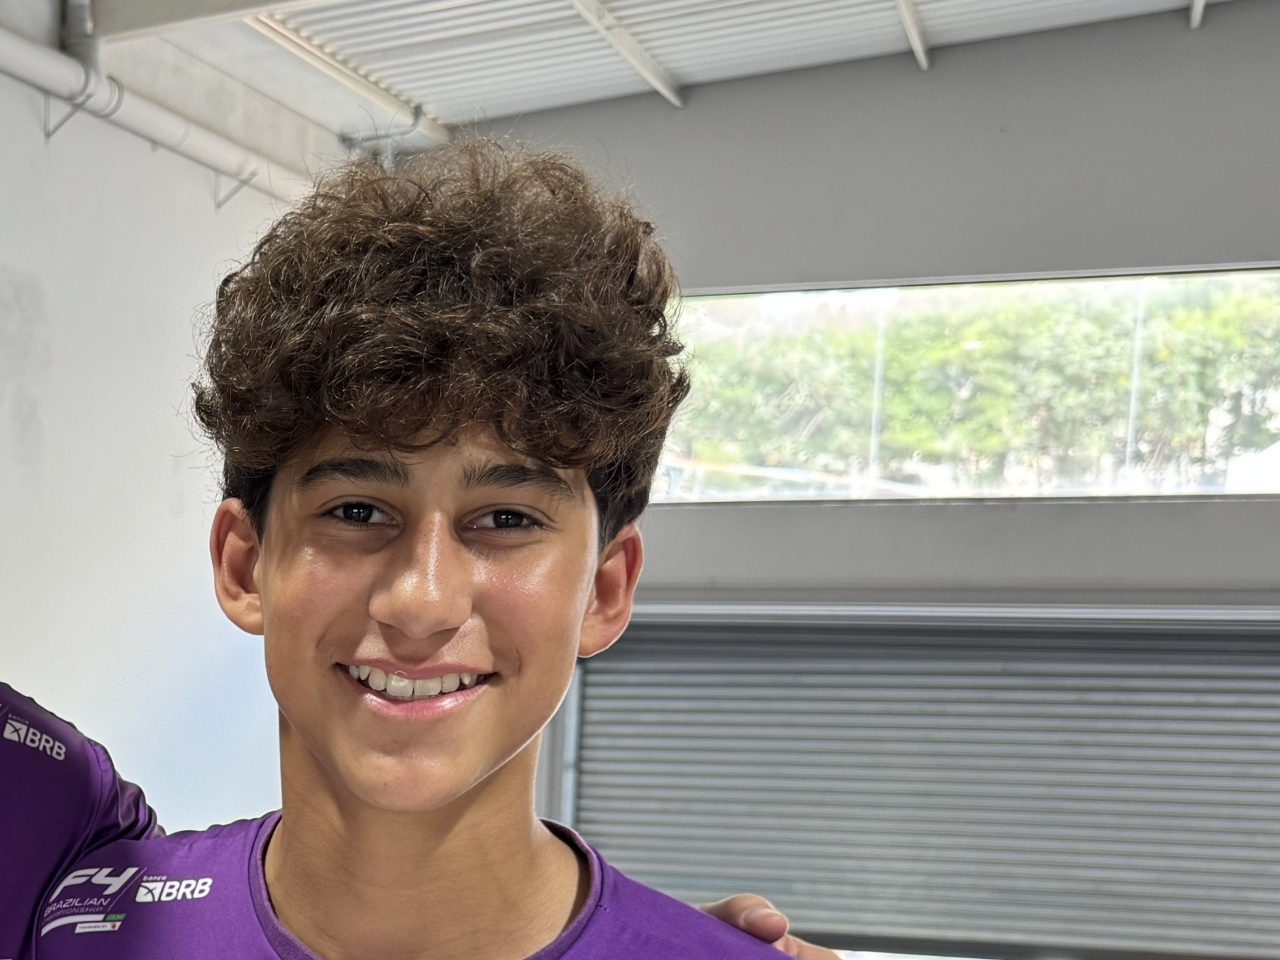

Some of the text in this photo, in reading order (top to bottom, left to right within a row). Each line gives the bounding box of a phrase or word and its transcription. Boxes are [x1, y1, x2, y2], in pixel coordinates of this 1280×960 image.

[25, 727, 67, 761] BRB
[49, 867, 139, 903] F4
[161, 877, 213, 902] BRB
